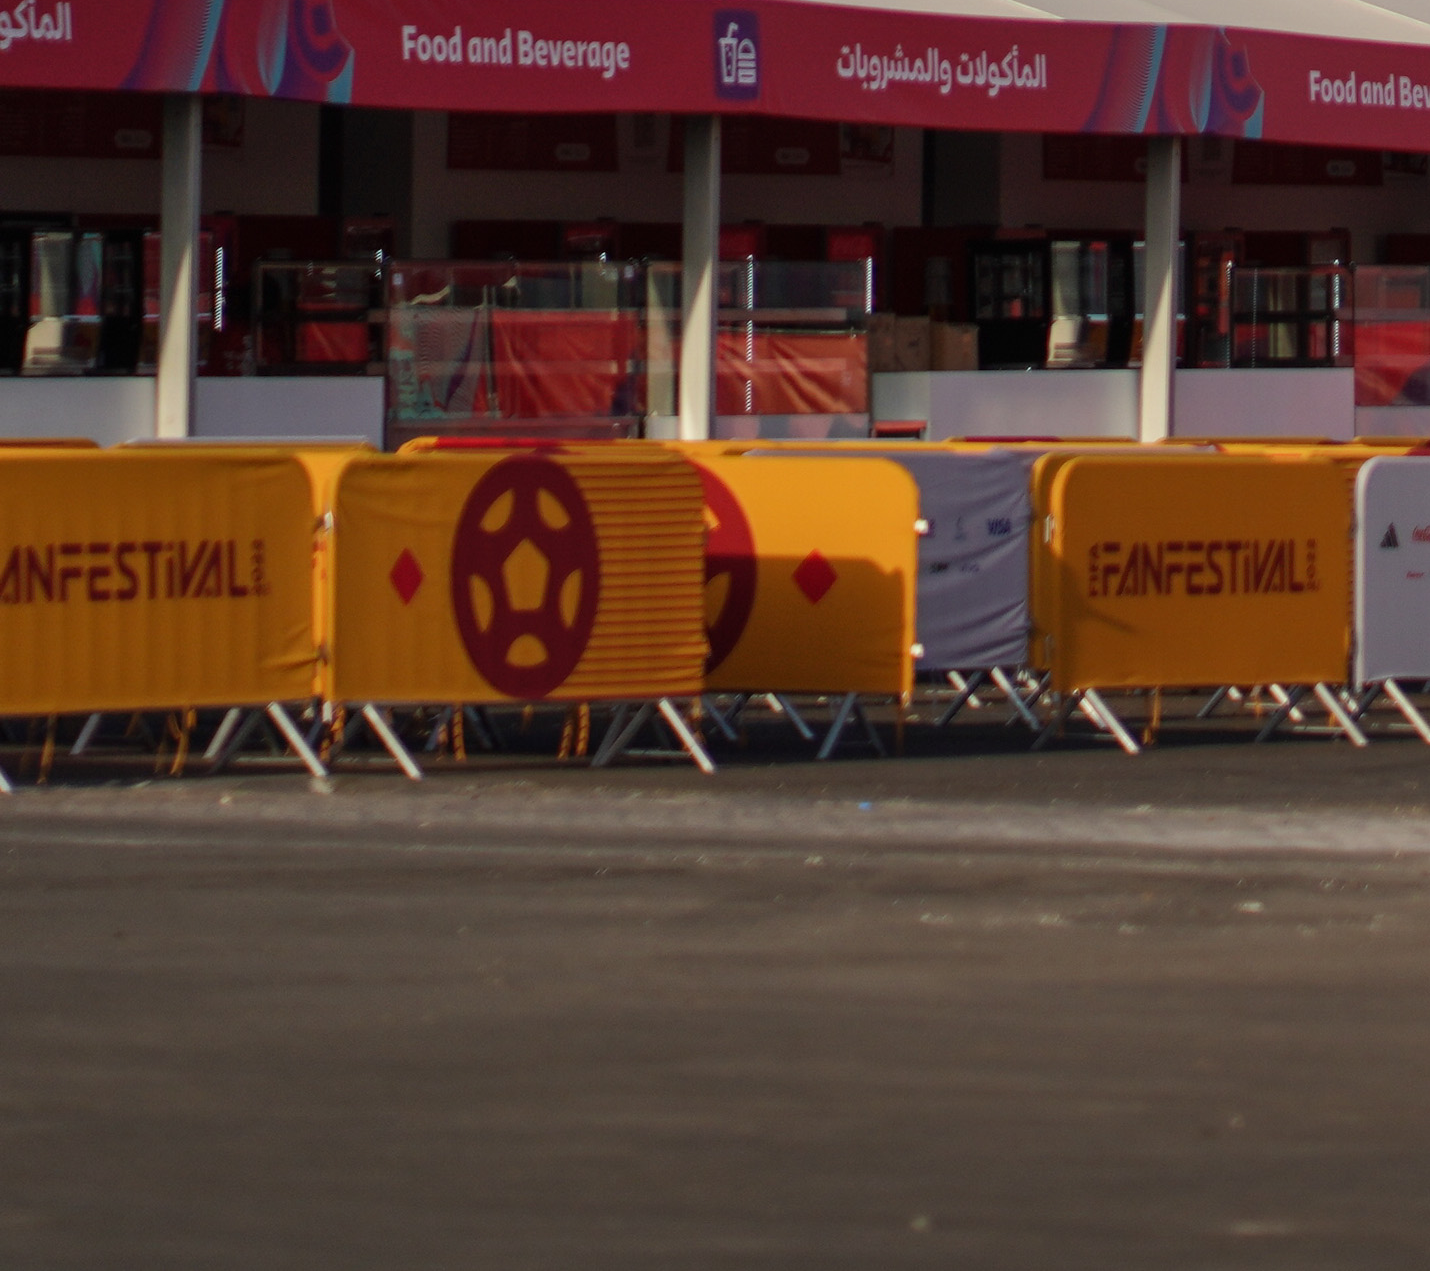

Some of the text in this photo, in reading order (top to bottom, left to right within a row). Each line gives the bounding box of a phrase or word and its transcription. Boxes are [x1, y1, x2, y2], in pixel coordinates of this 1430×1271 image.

[402, 25, 630, 78] Food and Beverage
[836, 43, 1047, 97] المأكولات والمشروبات
[1308, 69, 1357, 106] Food
[1361, 73, 1396, 109] and
